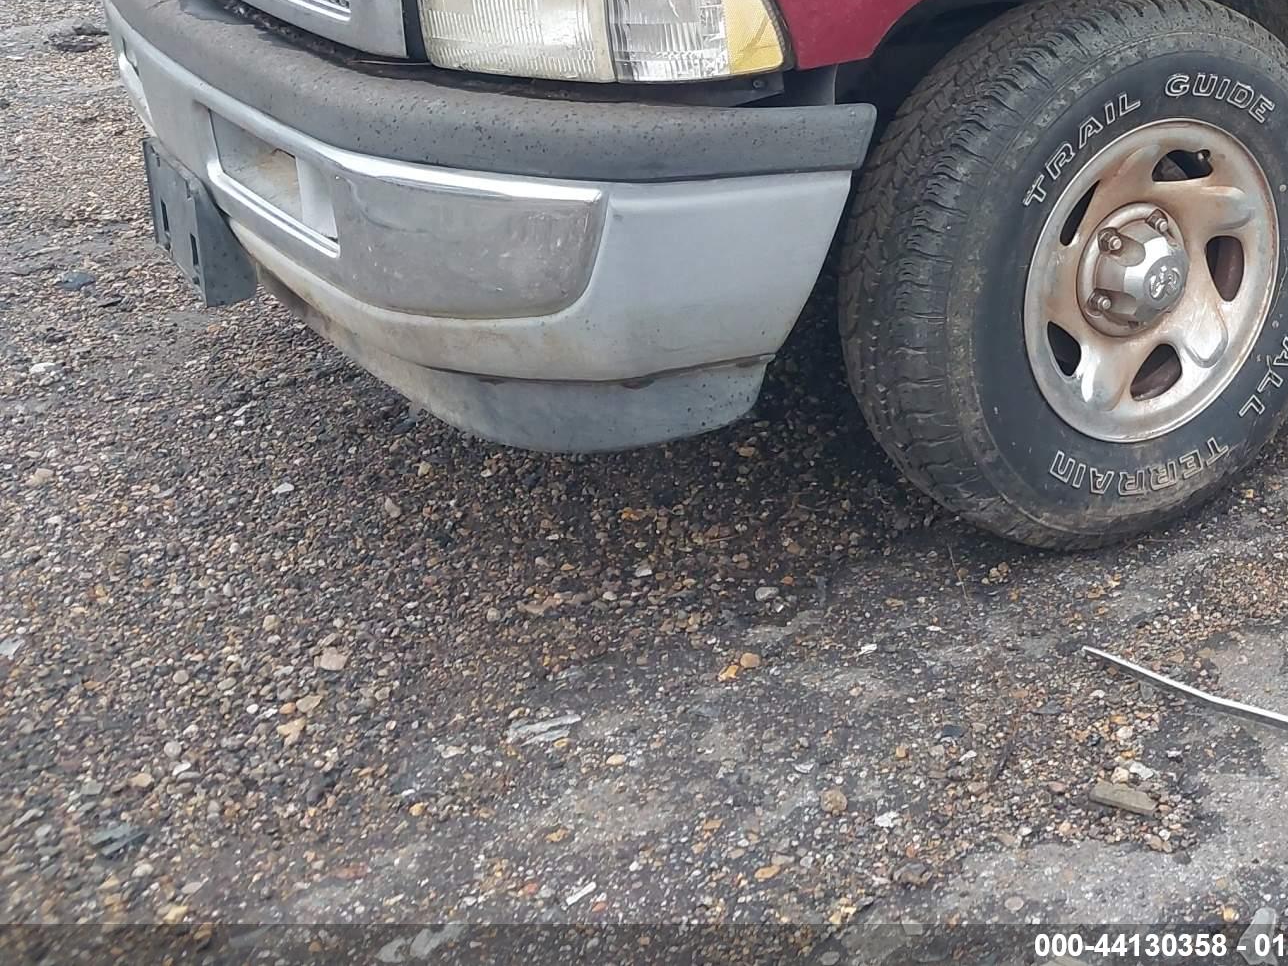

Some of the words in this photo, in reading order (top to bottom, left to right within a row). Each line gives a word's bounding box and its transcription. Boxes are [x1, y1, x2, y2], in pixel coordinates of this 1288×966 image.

[1023, 93, 1141, 207] TRAIL
[1164, 73, 1276, 124] GUIDE
[1049, 436, 1229, 497] TERRAIN
